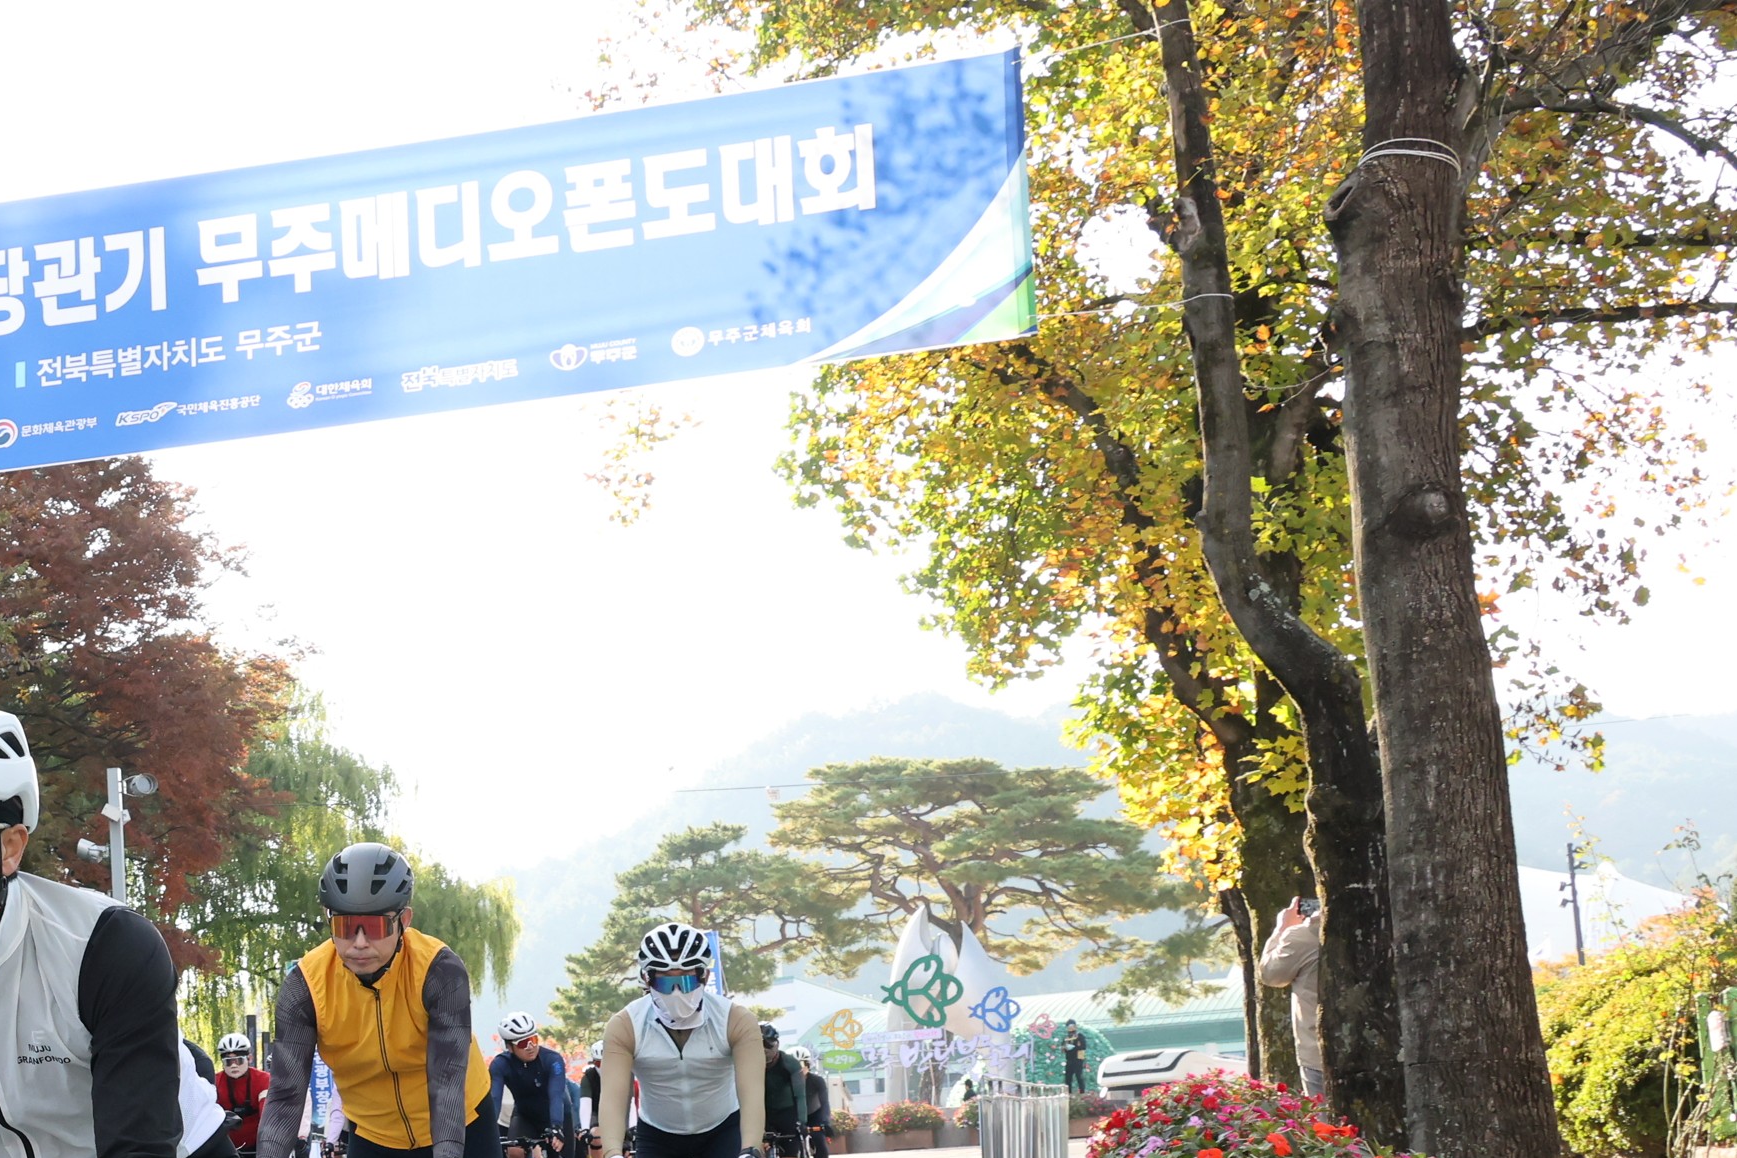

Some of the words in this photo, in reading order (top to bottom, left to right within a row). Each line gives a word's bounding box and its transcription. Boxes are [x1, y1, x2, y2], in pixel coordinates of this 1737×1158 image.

[195, 123, 875, 304] 무주메디오폰도대회
[707, 316, 812, 347] 무주군체육회
[36, 337, 226, 388] 전북특별자치도
[235, 321, 323, 362] 무주군
[315, 377, 373, 397] 대한체육회
[402, 358, 518, 392] 전북특별자치도
[176, 393, 262, 417] 국민체육진흥공단
[20, 416, 98, 438] 문화체육관광부
[117, 409, 161, 427] KSPO
[17, 1055, 71, 1065] GRANFONDO
